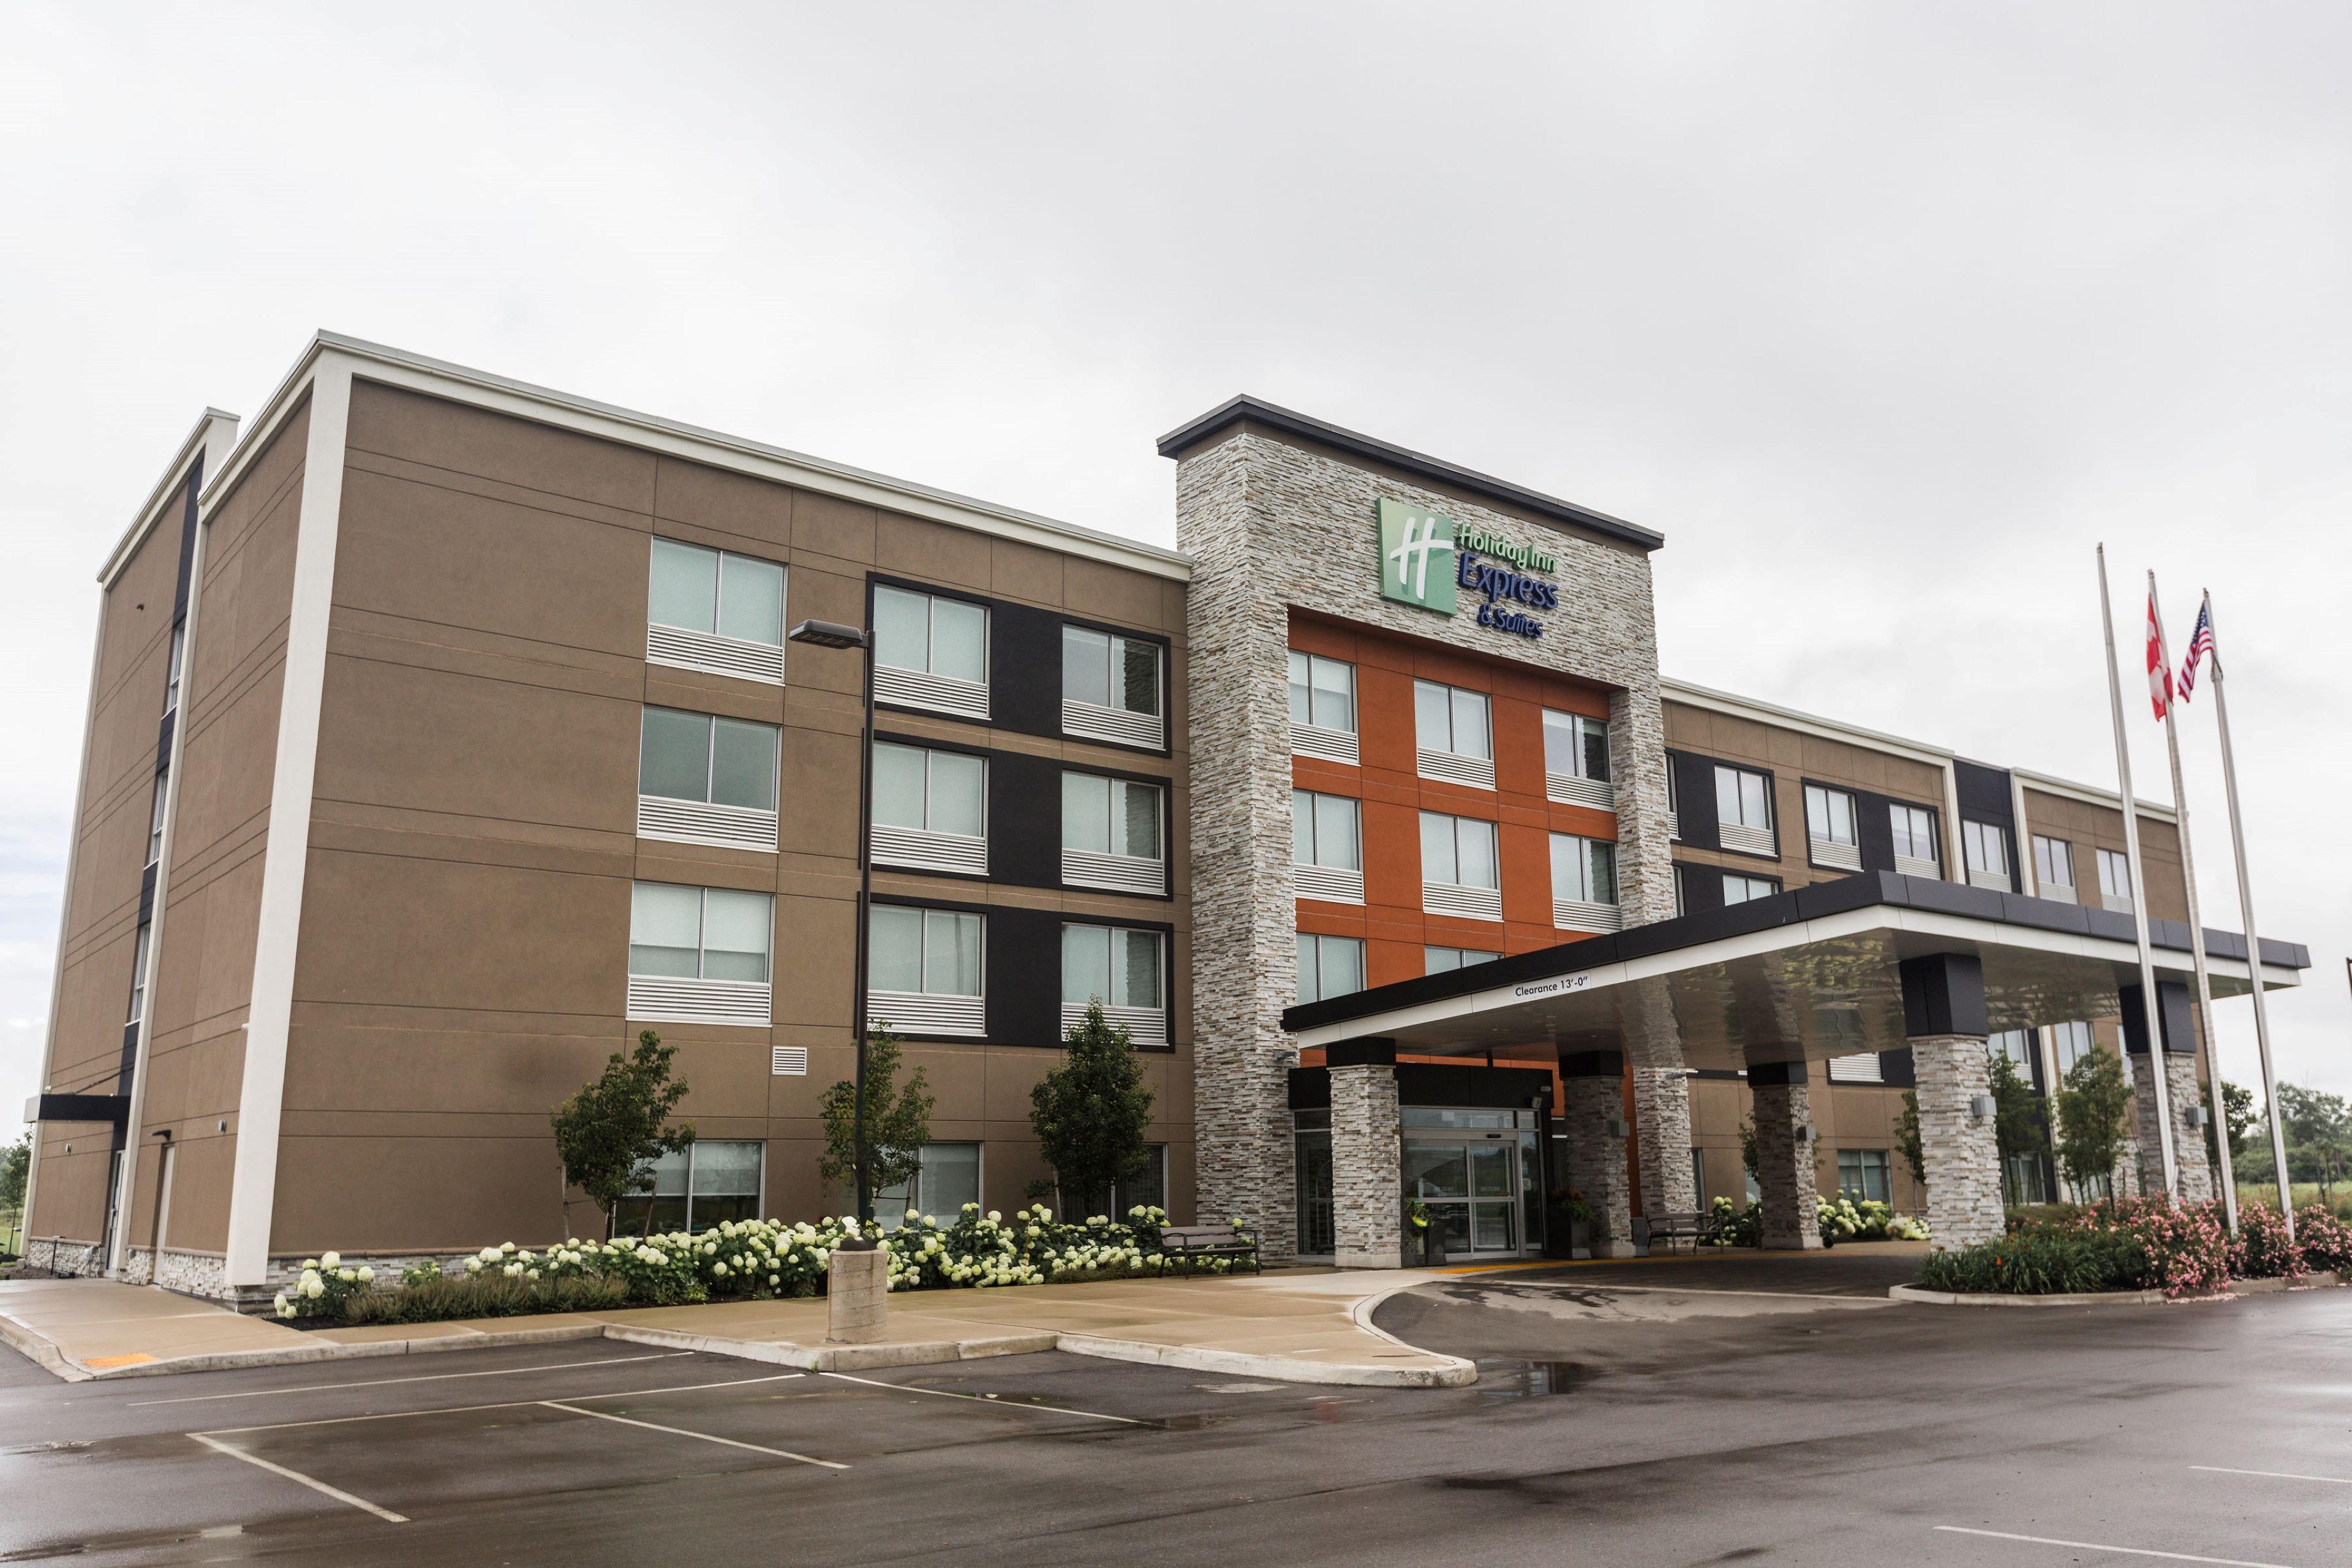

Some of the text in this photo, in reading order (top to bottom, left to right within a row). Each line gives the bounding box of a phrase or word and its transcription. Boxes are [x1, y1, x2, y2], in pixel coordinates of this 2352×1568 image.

[1457, 522, 1558, 573] Holiday Inn
[1459, 552, 1559, 610] Express
[1477, 603, 1544, 638] & Suites
[1515, 983, 1558, 997] Clearance
